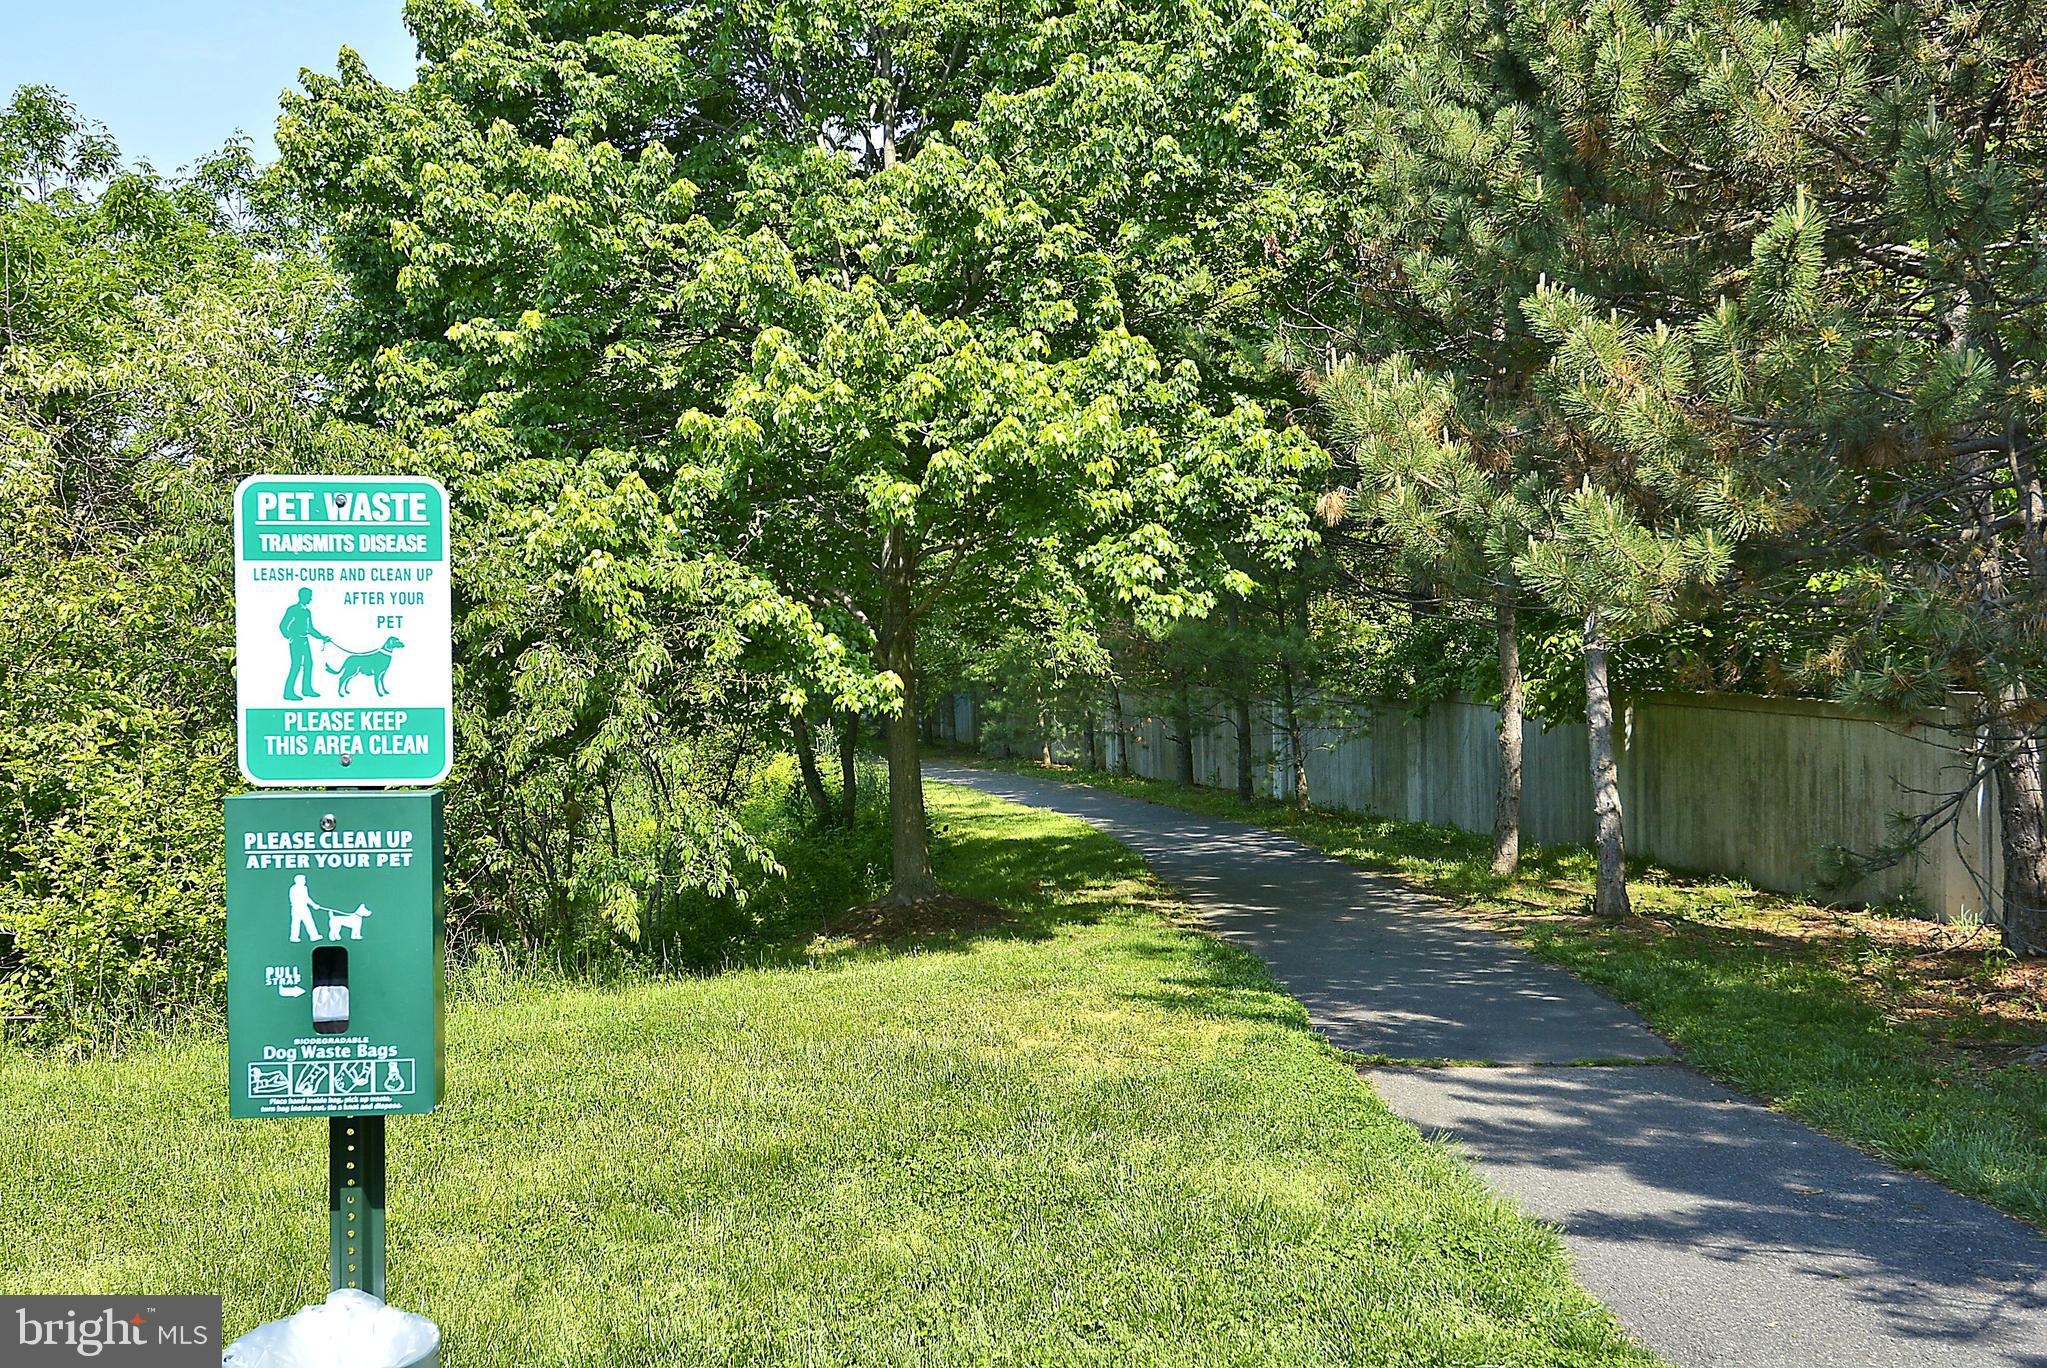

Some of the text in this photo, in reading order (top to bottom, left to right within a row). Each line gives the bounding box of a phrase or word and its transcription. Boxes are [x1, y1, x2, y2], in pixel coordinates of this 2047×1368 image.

[257, 492, 427, 522] PET WASTE
[258, 533, 428, 553] TRANSMITS DISEASE
[253, 567, 433, 582] LEASH-CURB AND CLEAN UP
[344, 591, 424, 605] AFTER YOUR
[377, 615, 403, 629] PET
[284, 711, 408, 732] PLEASE KEEP
[264, 734, 429, 755] THIS AREA CLEAN
[244, 831, 413, 850] PLEASE CLEAN UP
[246, 853, 413, 869] AFTER YOUR PET
[265, 966, 301, 979] PULL
[265, 978, 301, 986] STRAP
[293, 1036, 369, 1045] BIODEGRADABLE
[263, 1044, 398, 1061] Dog Waste Bags
